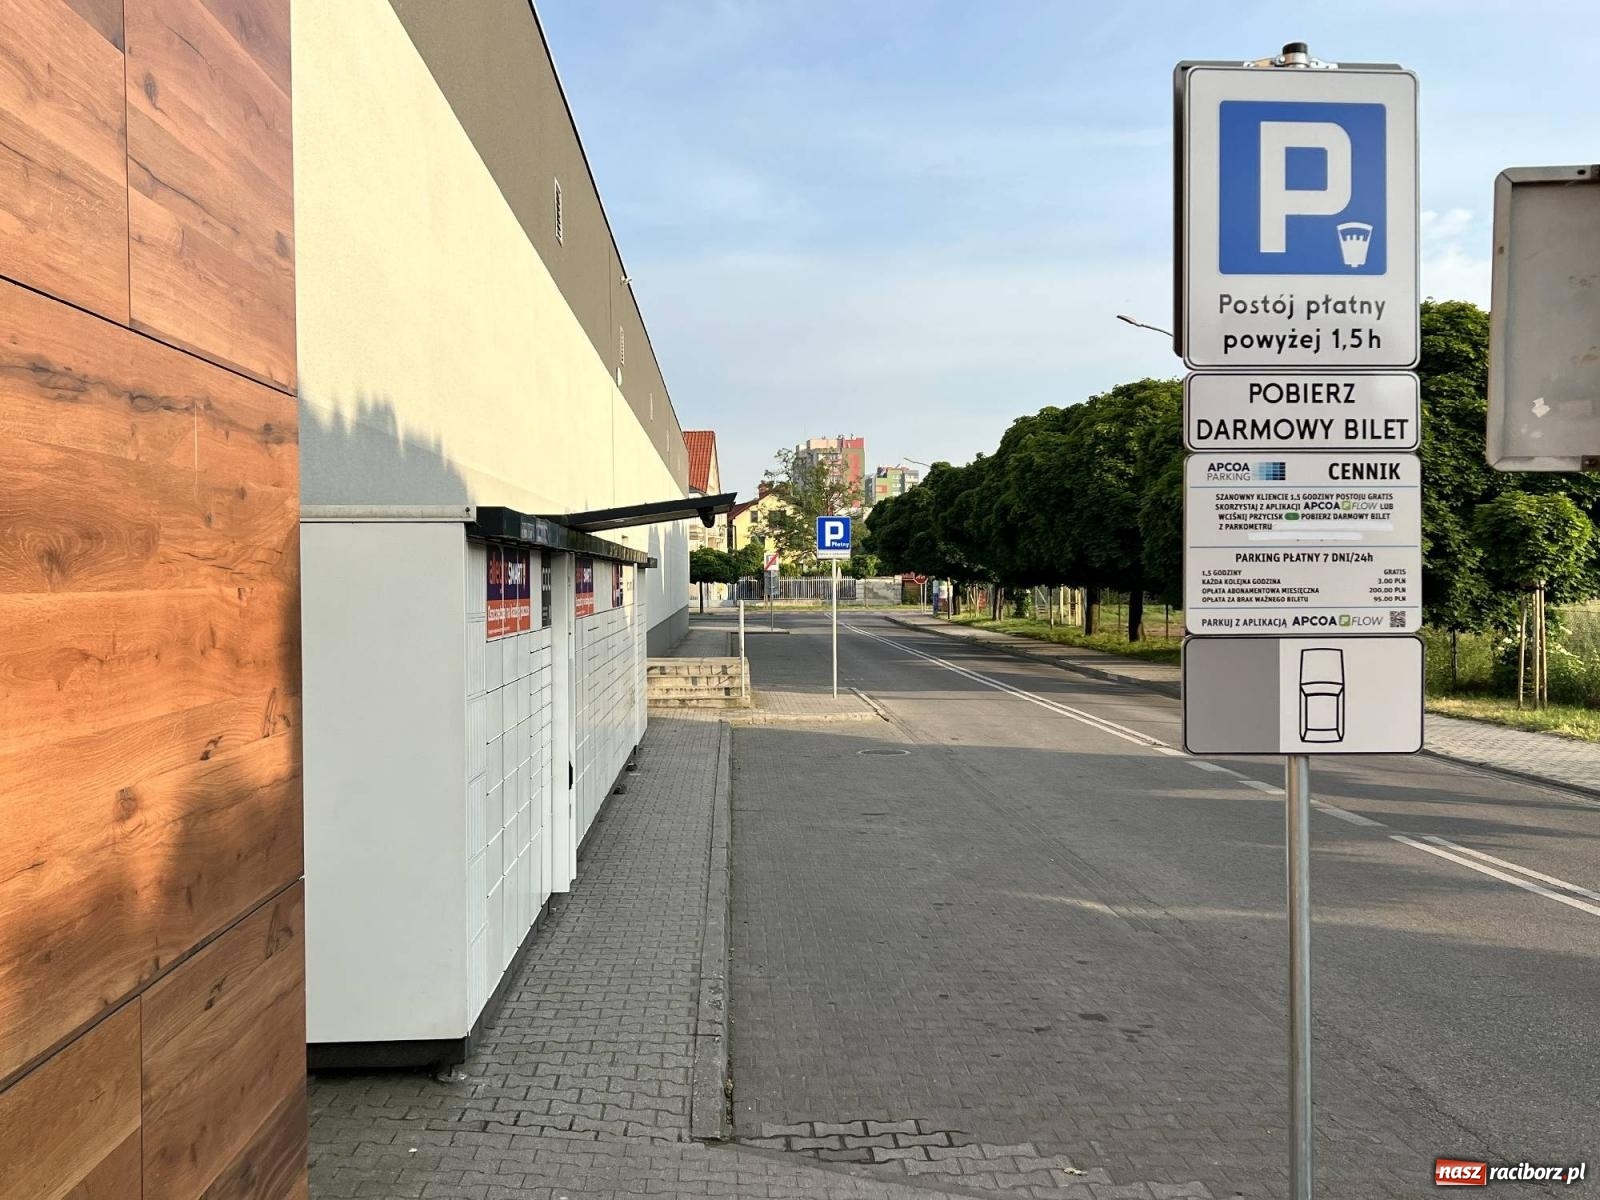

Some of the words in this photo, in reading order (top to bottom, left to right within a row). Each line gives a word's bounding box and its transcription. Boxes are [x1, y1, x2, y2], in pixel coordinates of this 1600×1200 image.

[1260, 121, 1351, 252] P
[1219, 294, 1294, 320] Postój
[1307, 294, 1386, 320] płatny
[1224, 328, 1321, 354] powyżej
[1250, 383, 1356, 404] POBIERZ
[1197, 419, 1334, 440] DARMOWY
[1345, 419, 1409, 440] BILET
[1207, 462, 1250, 472] APCOA
[1329, 462, 1401, 480] CENNIK
[1207, 472, 1250, 481] PARKING
[1216, 493, 1254, 501] SZANOWNY
[1336, 493, 1366, 501] POSTOJU
[1215, 503, 1258, 511] SKORZYSTAJ
[1266, 503, 1301, 511] APLIKACJI
[1304, 502, 1340, 510] APCOA
[1352, 502, 1378, 510] FLOW
[1218, 512, 1248, 521] WCIŚNIJ
[825, 521, 844, 547] P
[1235, 553, 1281, 563] PARKING
[1283, 553, 1320, 562] PŁATNY
[1323, 553, 1329, 562] 7
[1332, 552, 1374, 563] DNI/24h
[1201, 618, 1233, 628] PARKUJ
[1235, 618, 1241, 626] Z
[1243, 618, 1288, 628] APLIKACJĄ
[1292, 616, 1338, 626] APCOA
[1351, 616, 1384, 626] FLOW
